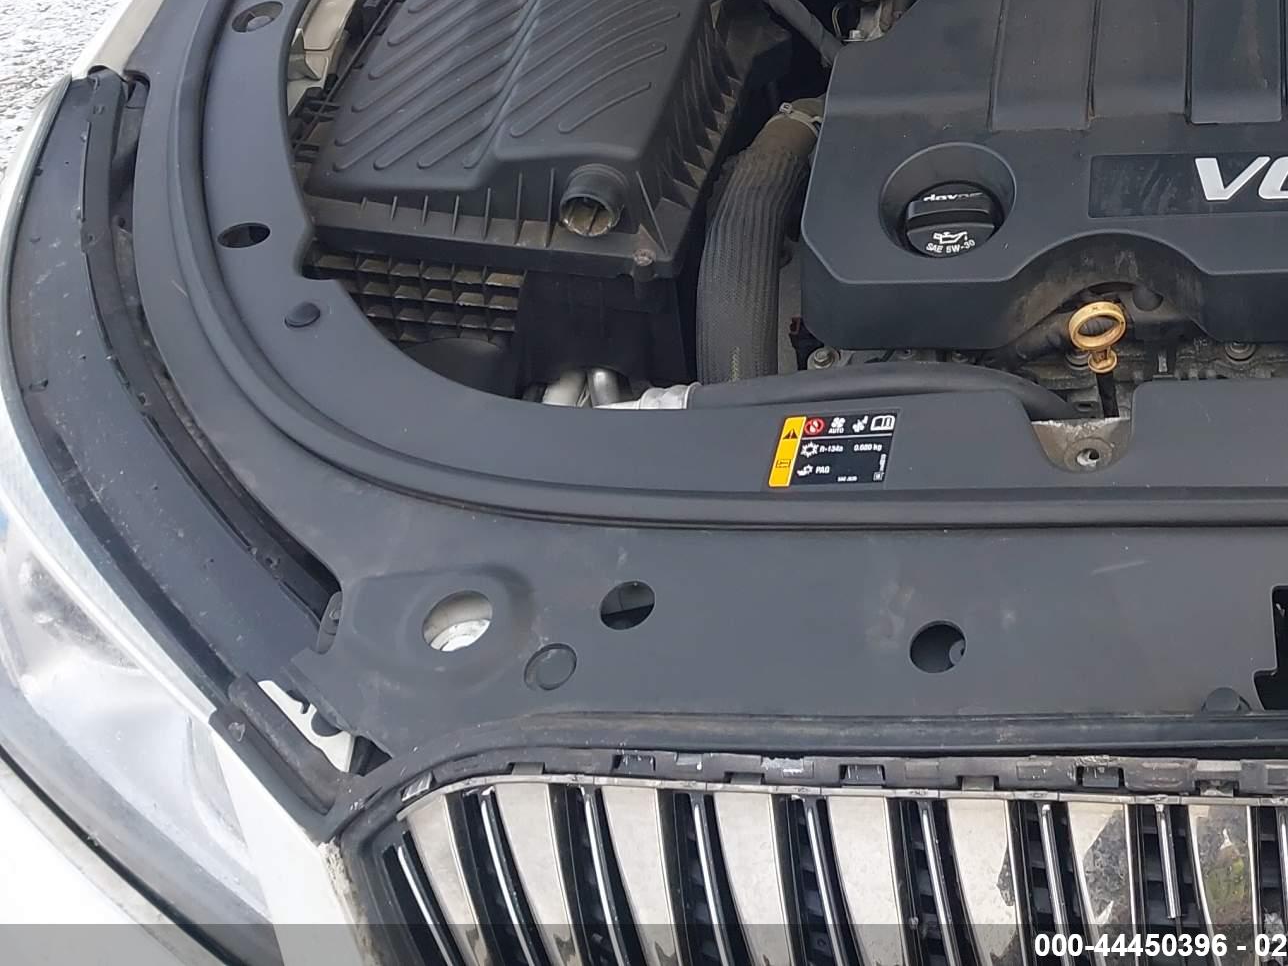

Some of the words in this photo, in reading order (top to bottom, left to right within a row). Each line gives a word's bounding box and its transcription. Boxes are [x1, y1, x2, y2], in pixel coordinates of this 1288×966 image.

[926, 242, 944, 254] SAE
[946, 239, 976, 254] 5W-30
[828, 426, 845, 434] AUTO
